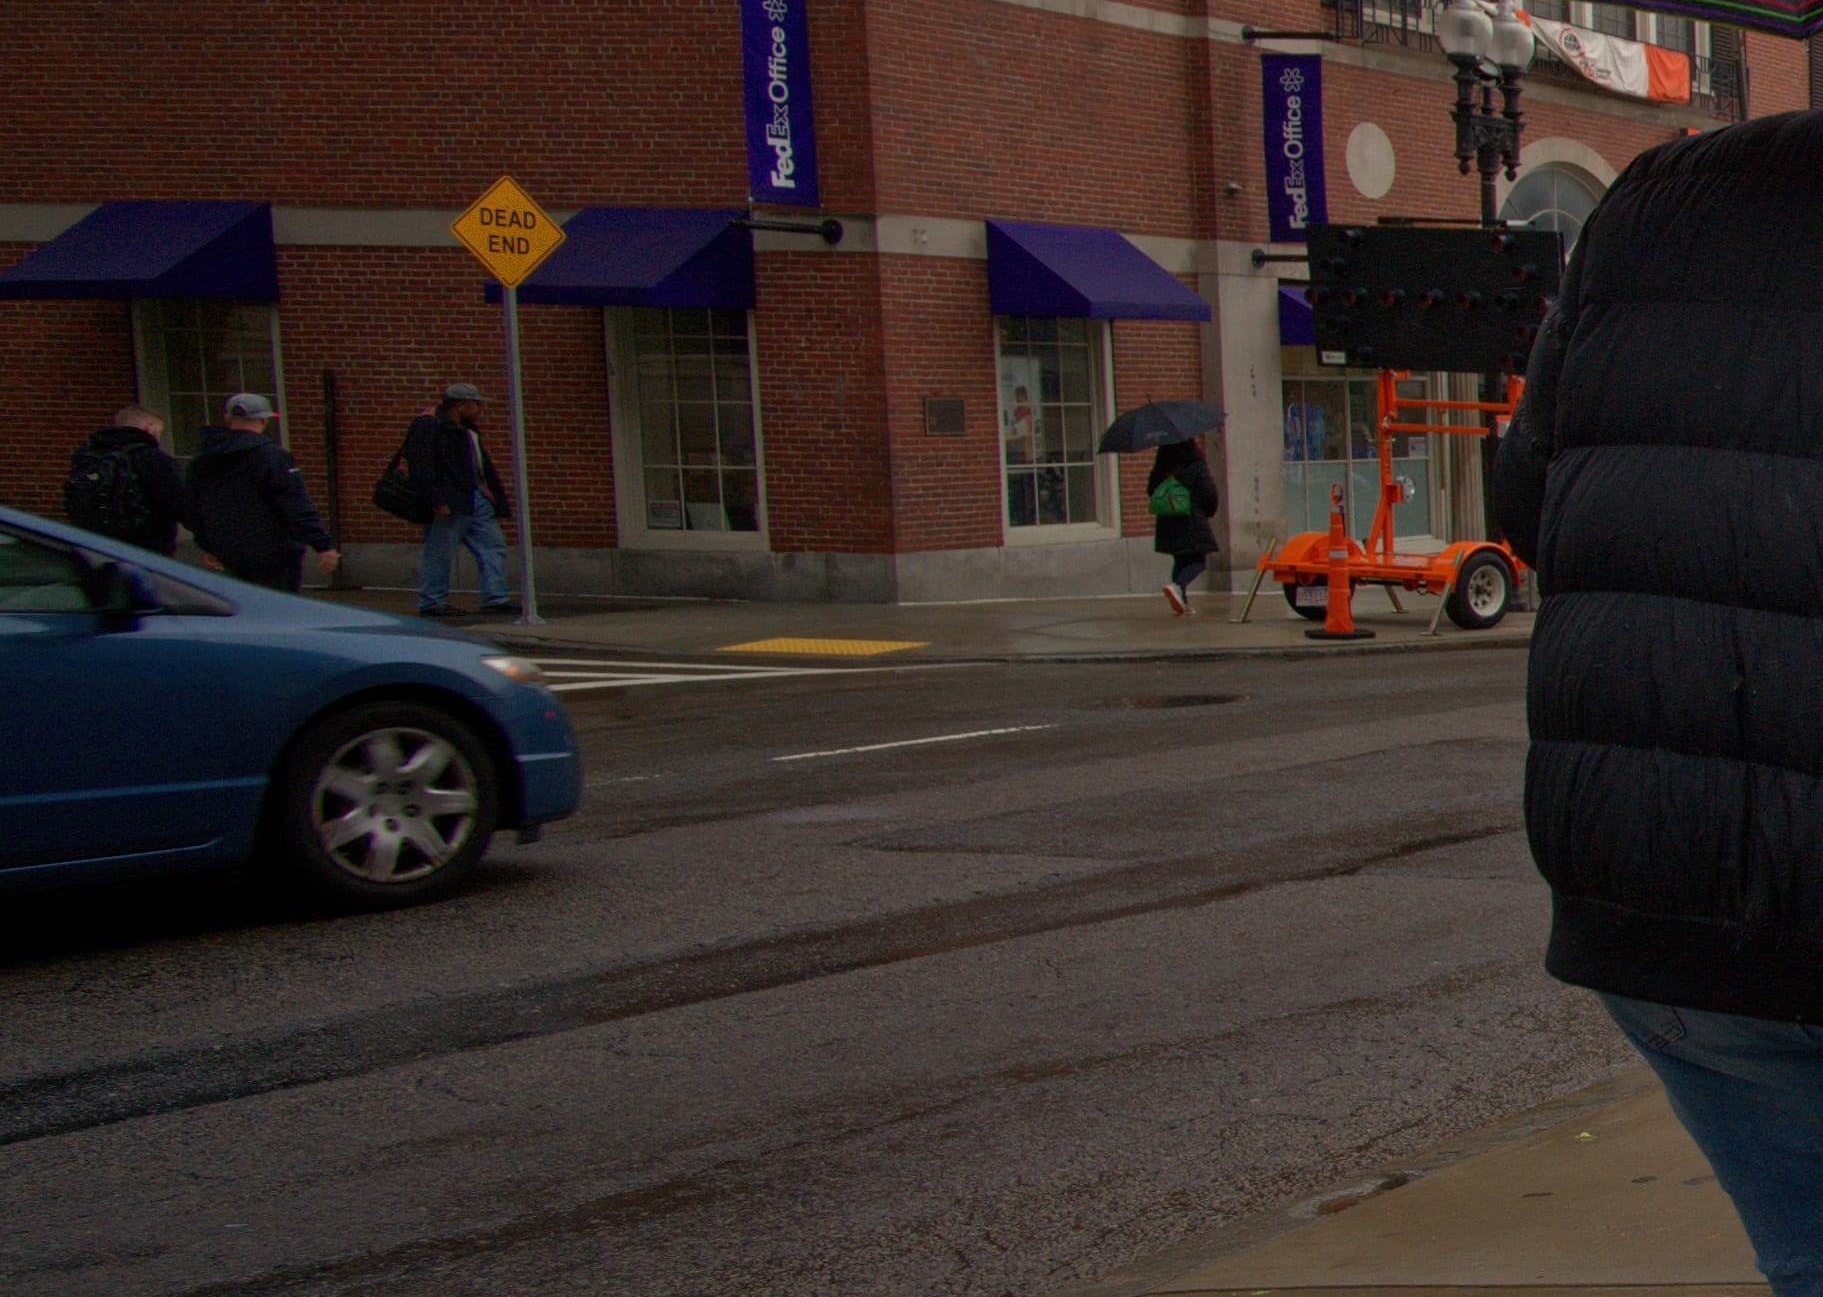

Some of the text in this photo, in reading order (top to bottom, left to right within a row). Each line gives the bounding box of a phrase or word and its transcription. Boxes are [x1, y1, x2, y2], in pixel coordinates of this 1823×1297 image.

[766, 26, 796, 189] FedEx Office
[1284, 95, 1304, 159] Office
[480, 207, 536, 229] DEAD
[488, 235, 530, 255] END
